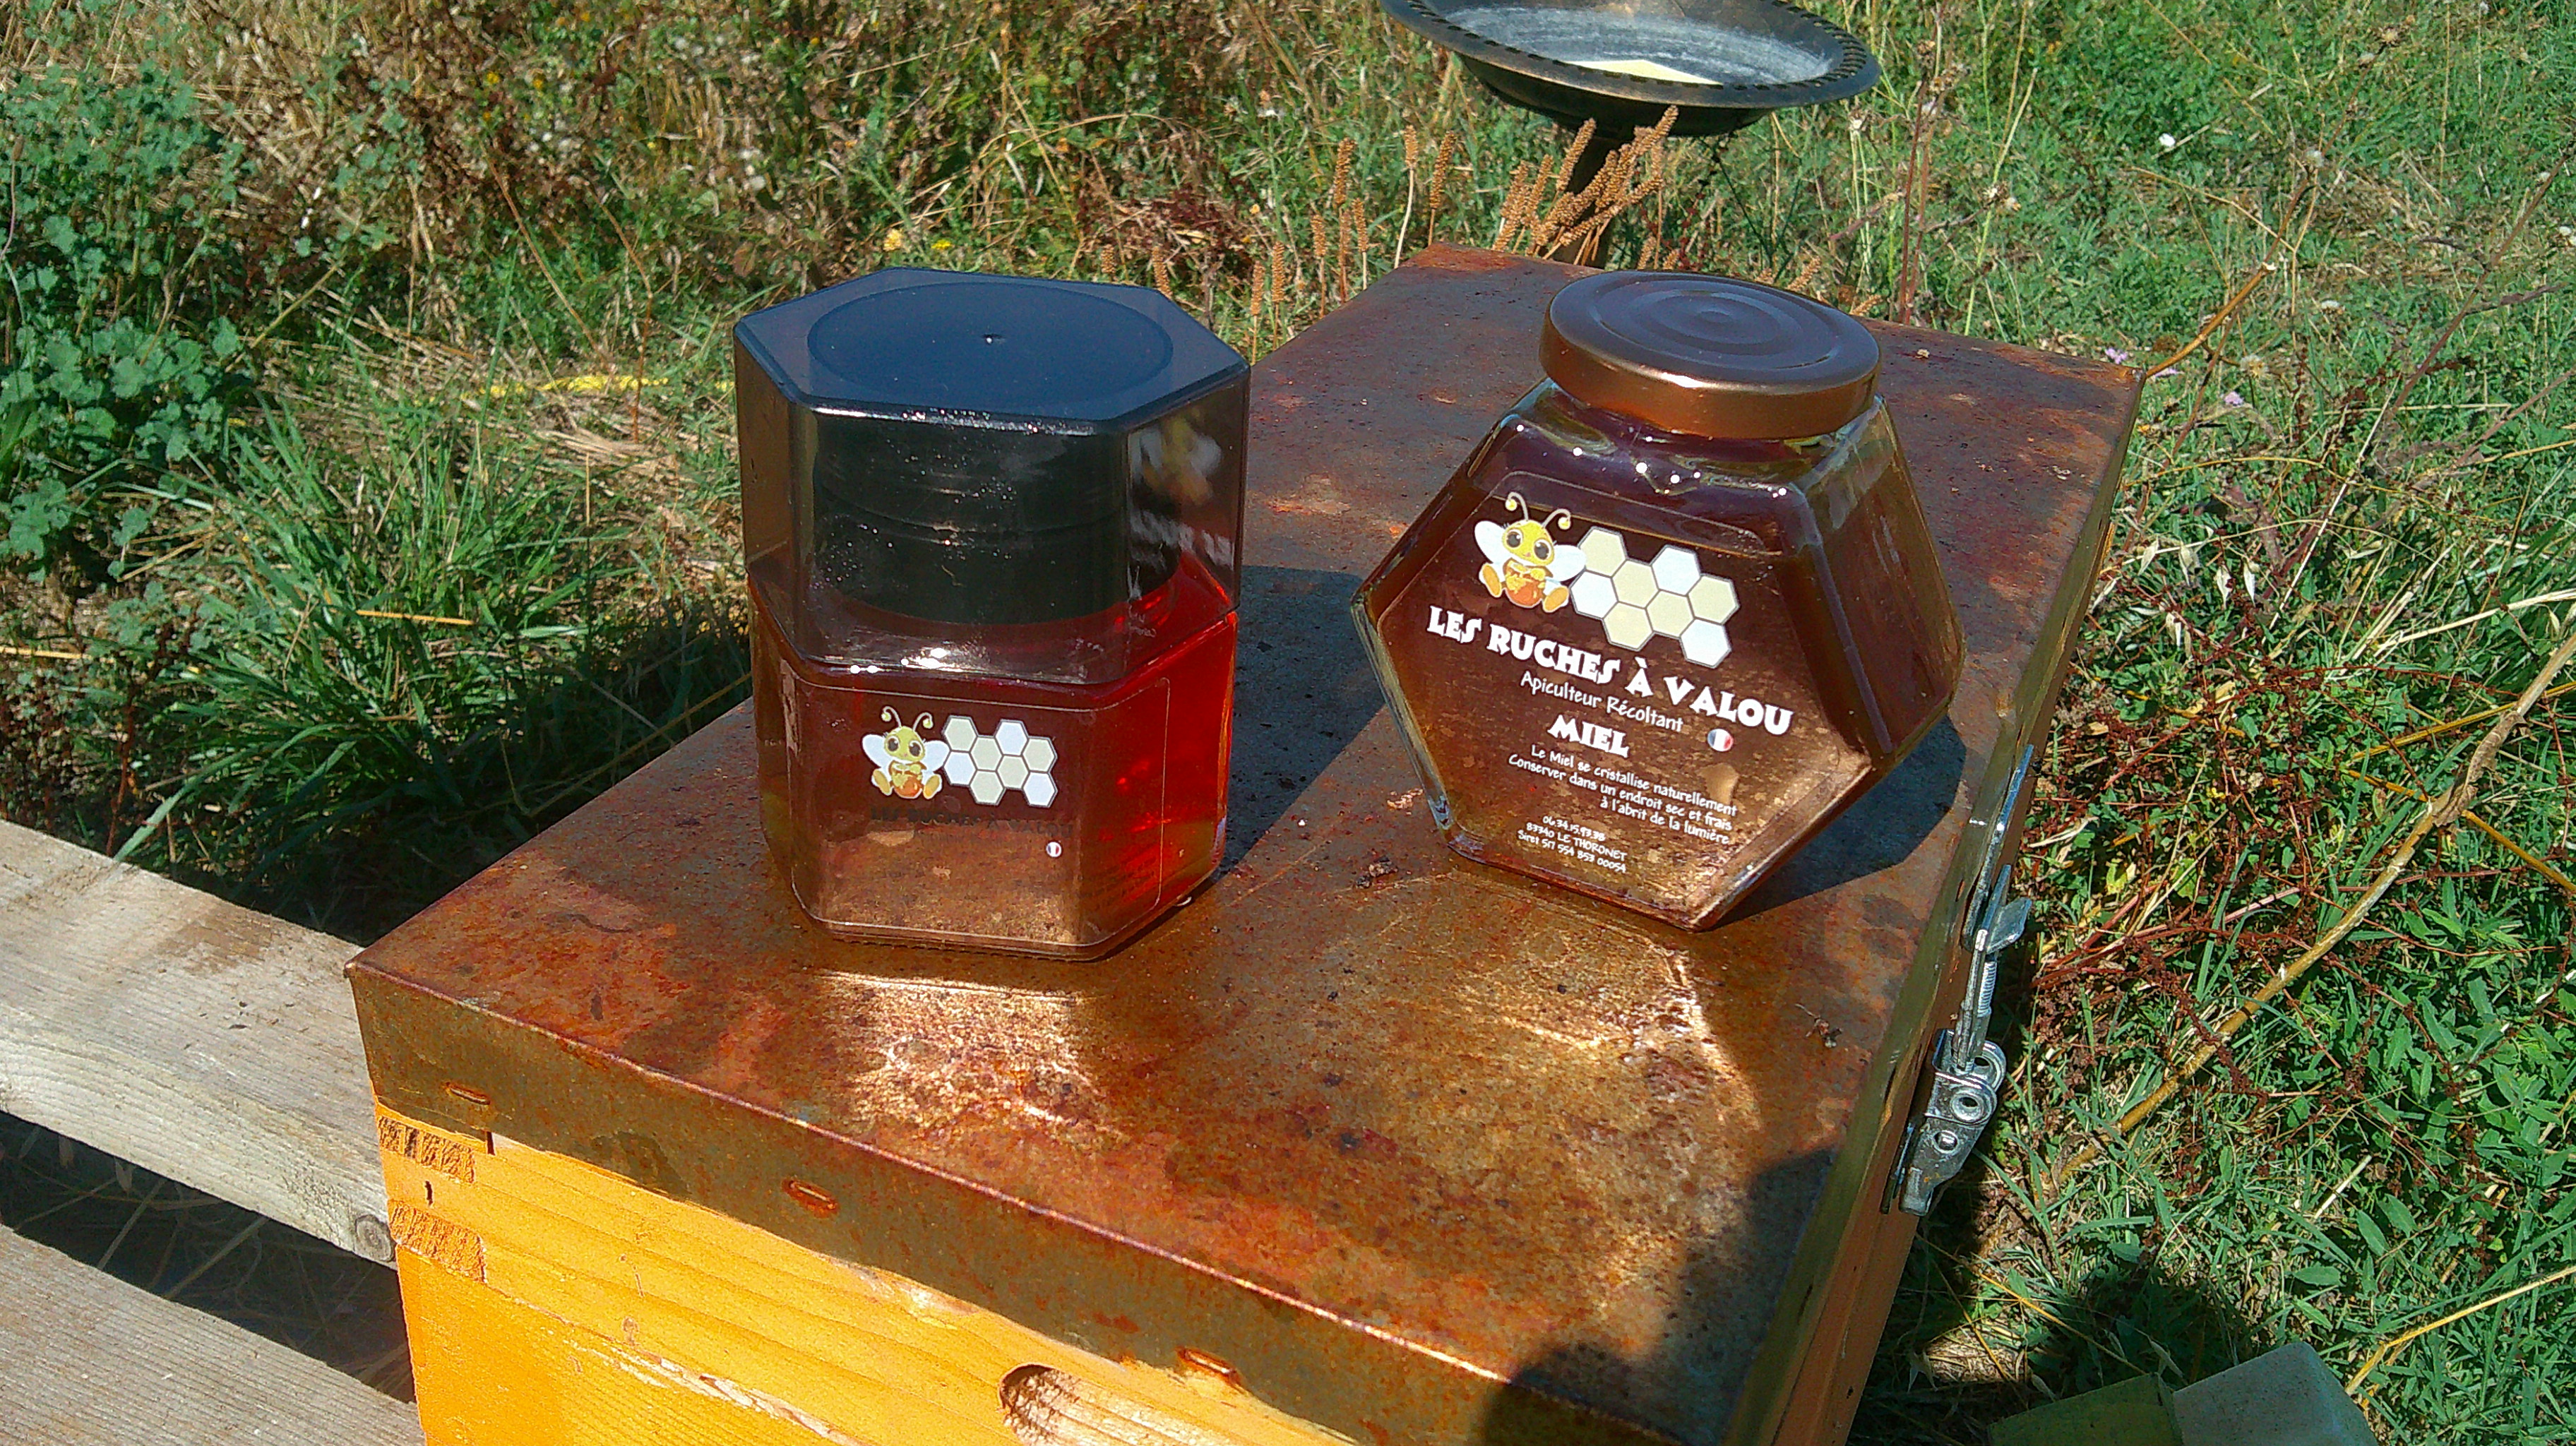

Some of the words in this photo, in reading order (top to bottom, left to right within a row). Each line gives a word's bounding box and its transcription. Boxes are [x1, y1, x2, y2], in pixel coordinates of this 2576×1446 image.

[1426, 606, 1482, 643] LES
[1486, 623, 1621, 684] RUCHES
[1624, 657, 1654, 698] À
[1663, 676, 1795, 735] VALOU
[1520, 671, 1602, 707] Apiculteur
[1606, 696, 1684, 731] Récoltant
[1547, 715, 1630, 758] MIEL
[1508, 754, 1567, 780] Conserver
[1569, 772, 1597, 790] dans
[1600, 784, 1616, 796] un
[1619, 791, 1663, 810] endroit
[1665, 803, 1685, 816] sec
[1688, 810, 1701, 821] et
[1705, 812, 1733, 831] frais
[1531, 744, 1546, 758] Le
[1549, 751, 1575, 767] Miel
[1578, 761, 1591, 772] se
[1594, 767, 1650, 790] cristallise
[1653, 784, 1738, 816] naturellement
[1526, 822, 1555, 838] 83340
[1557, 832, 1571, 843] LE
[1573, 837, 1628, 861] THORONET
[1599, 796, 1609, 808] à
[1611, 799, 1647, 820] l'abrit
[1650, 811, 1665, 825] de
[1669, 815, 1681, 830] la
[1684, 820, 1729, 844] lumière
[1517, 830, 1540, 845] Siret
[1558, 844, 1575, 856] 554
[1577, 850, 1596, 862] 853
[1597, 857, 1627, 874] 00054
